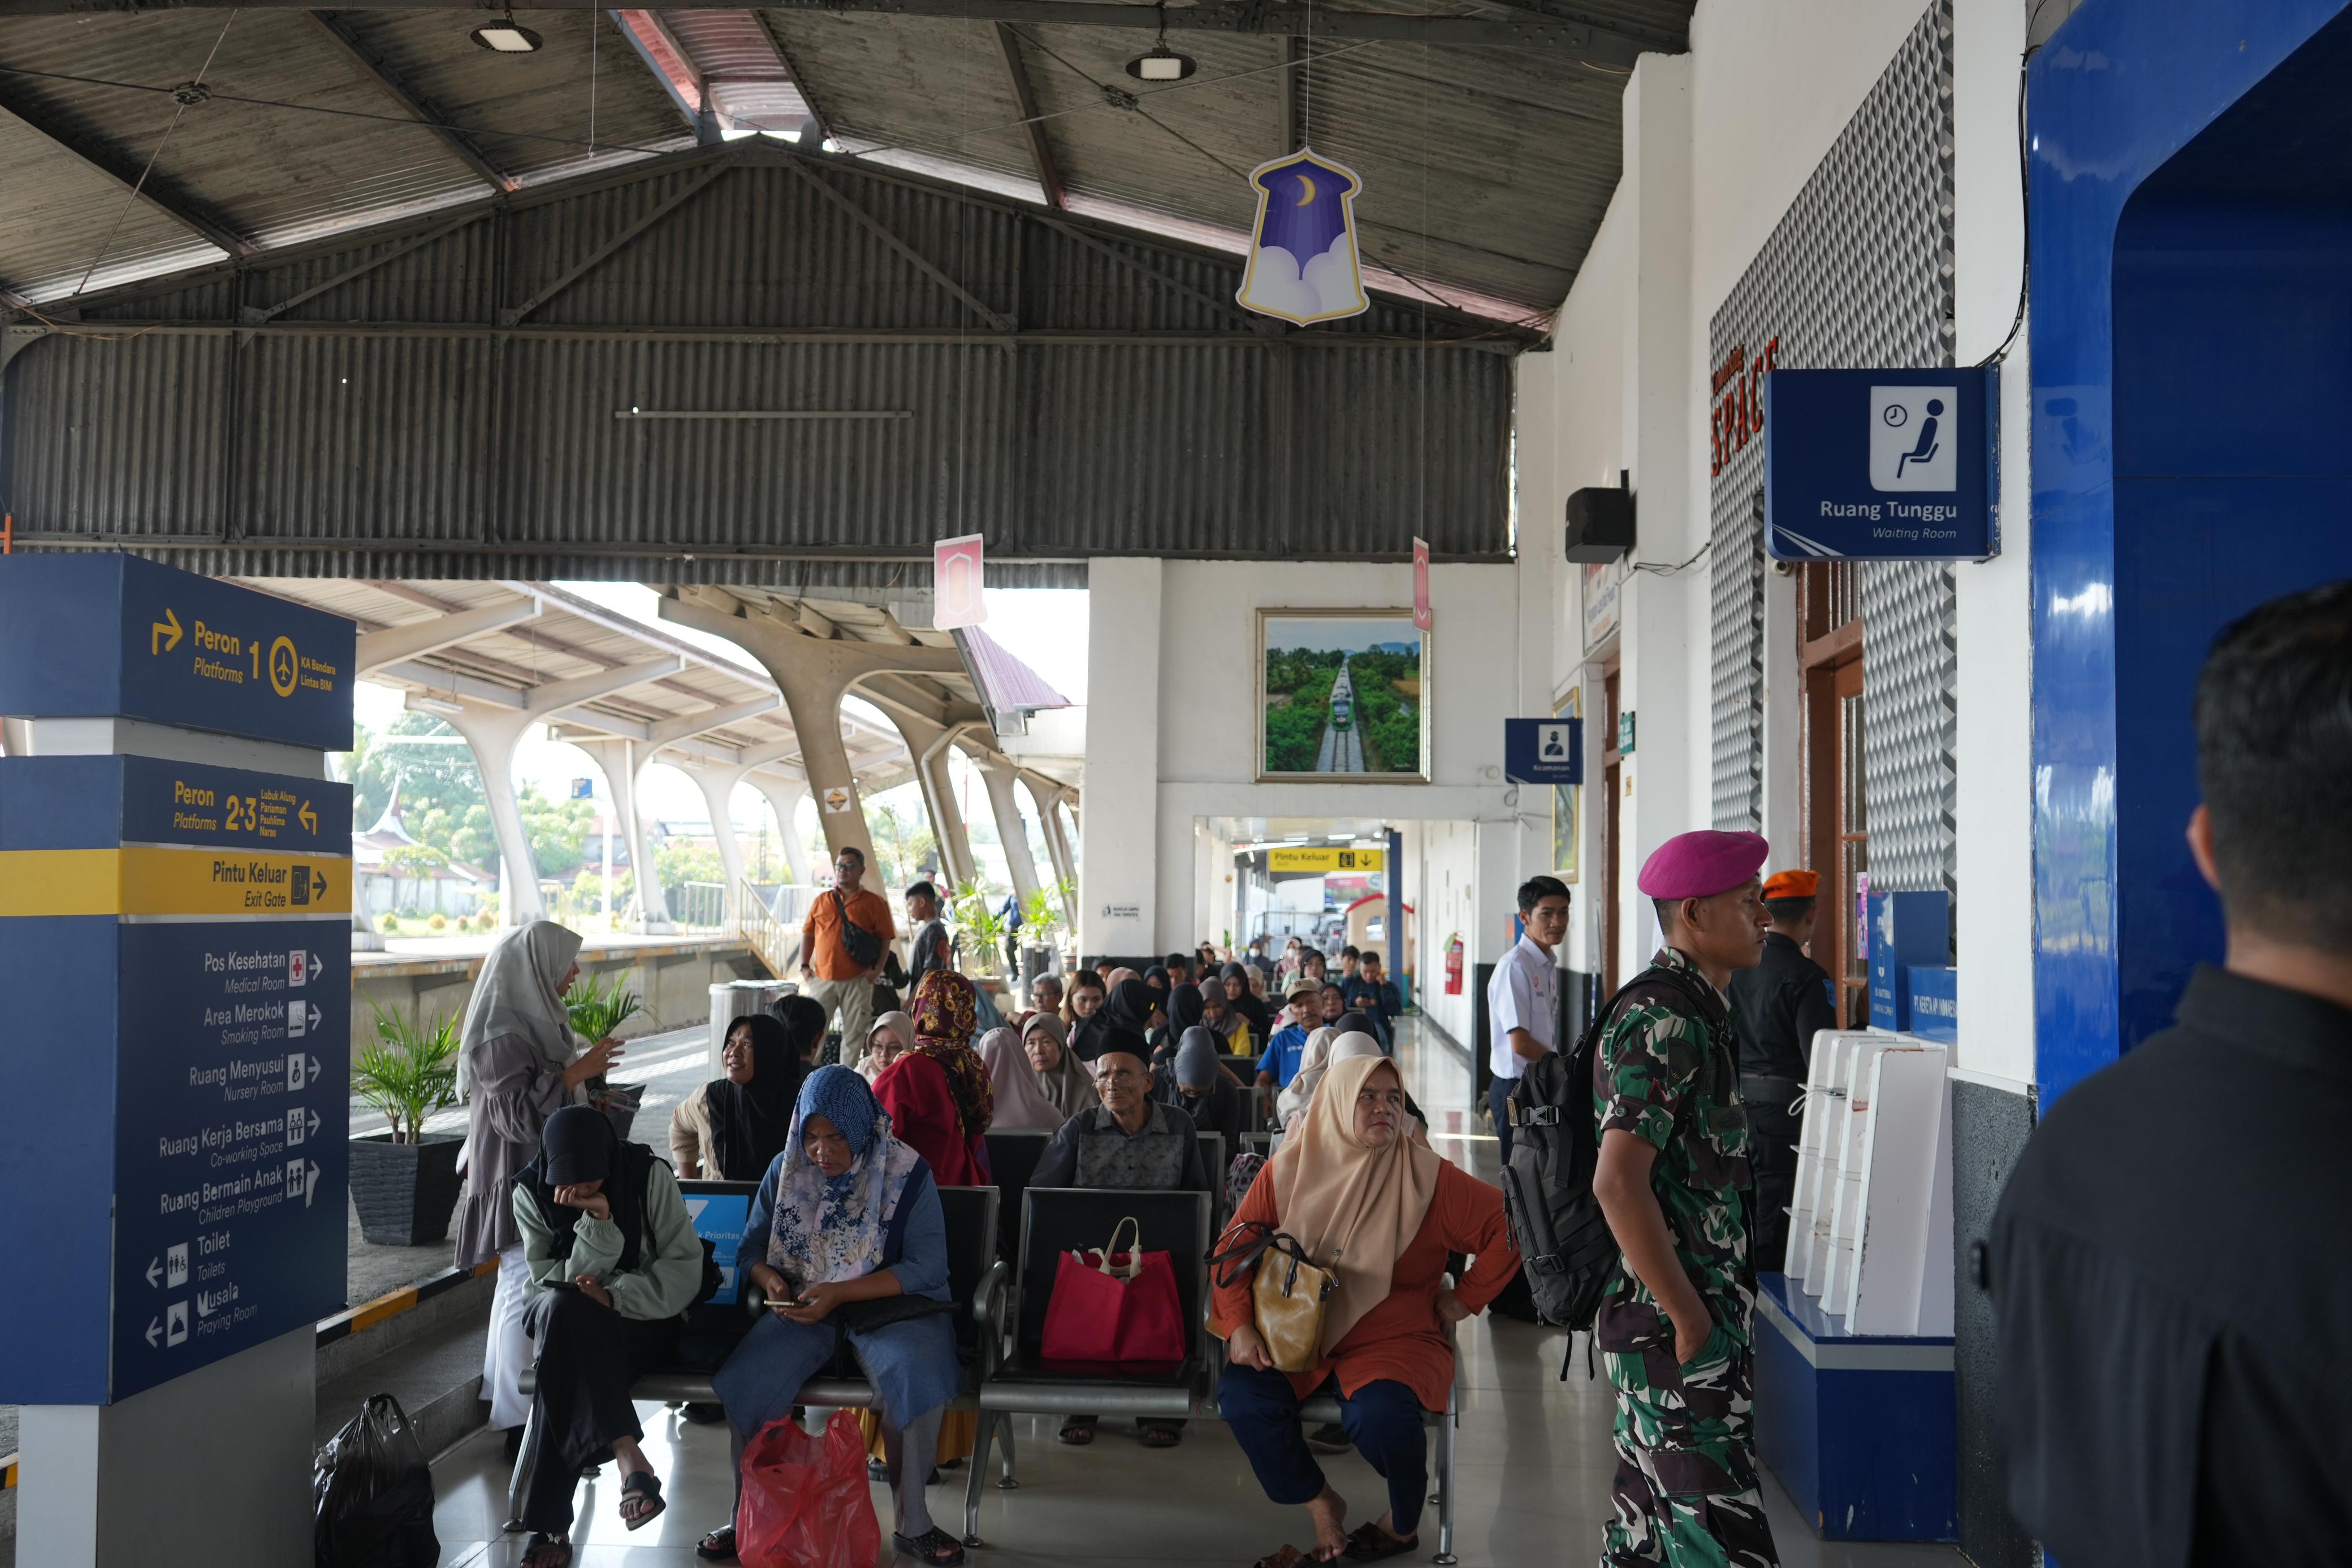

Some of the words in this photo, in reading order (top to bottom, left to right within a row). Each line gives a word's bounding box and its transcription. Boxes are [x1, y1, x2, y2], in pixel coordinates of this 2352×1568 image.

[1821, 500, 1882, 521] Ruang
[1887, 501, 1957, 522] Tunggu
[1873, 527, 1918, 541] Waiting
[1922, 528, 1957, 539] Room
[194, 620, 240, 656] Peron
[193, 657, 244, 683] Platforms
[249, 641, 259, 679] 1
[301, 656, 311, 669] KA
[312, 659, 336, 675] Bandara
[301, 674, 319, 689] Lintas
[320, 679, 332, 692] BIM
[175, 781, 215, 807] Peron
[261, 789, 279, 801] Lubuk
[279, 791, 297, 805] Alung
[260, 802, 287, 815] Pariaman
[173, 812, 217, 831] Platforms
[260, 815, 286, 826] Pauhlima
[260, 826, 276, 837] Naras
[213, 860, 245, 882] Pintu
[249, 862, 287, 883] Keluar
[244, 890, 263, 907] Exit
[264, 891, 286, 907] Gate
[205, 952, 225, 972] Pos
[228, 950, 286, 971] Kesehatan
[224, 976, 261, 994] Medical
[262, 976, 285, 990] Room
[204, 1007, 231, 1026] Area
[235, 1000, 284, 1024] Merokok
[1939, 998, 1957, 1018] INDONESI
[221, 1025, 259, 1045] Smoking
[261, 1025, 284, 1039] Room
[189, 1066, 226, 1086] Ruang
[230, 1053, 284, 1080] Menyusui
[224, 1082, 258, 1102] Nursery
[261, 1080, 283, 1095] Room
[159, 1136, 198, 1158] Ruang
[201, 1124, 232, 1149] Kerja
[235, 1117, 283, 1141] Bersama
[210, 1145, 257, 1168] Co-working
[260, 1141, 283, 1158] Space
[161, 1190, 199, 1215] Ruang
[202, 1173, 251, 1203] Bermain
[254, 1164, 283, 1189] Anak
[198, 1204, 235, 1225] Children
[237, 1188, 283, 1214] Playground
[197, 1230, 230, 1256] Toilet
[704, 1231, 740, 1240] Prioritas
[197, 1261, 226, 1281] Toilets
[197, 1314, 231, 1337] Praying
[234, 1305, 257, 1323] Room
